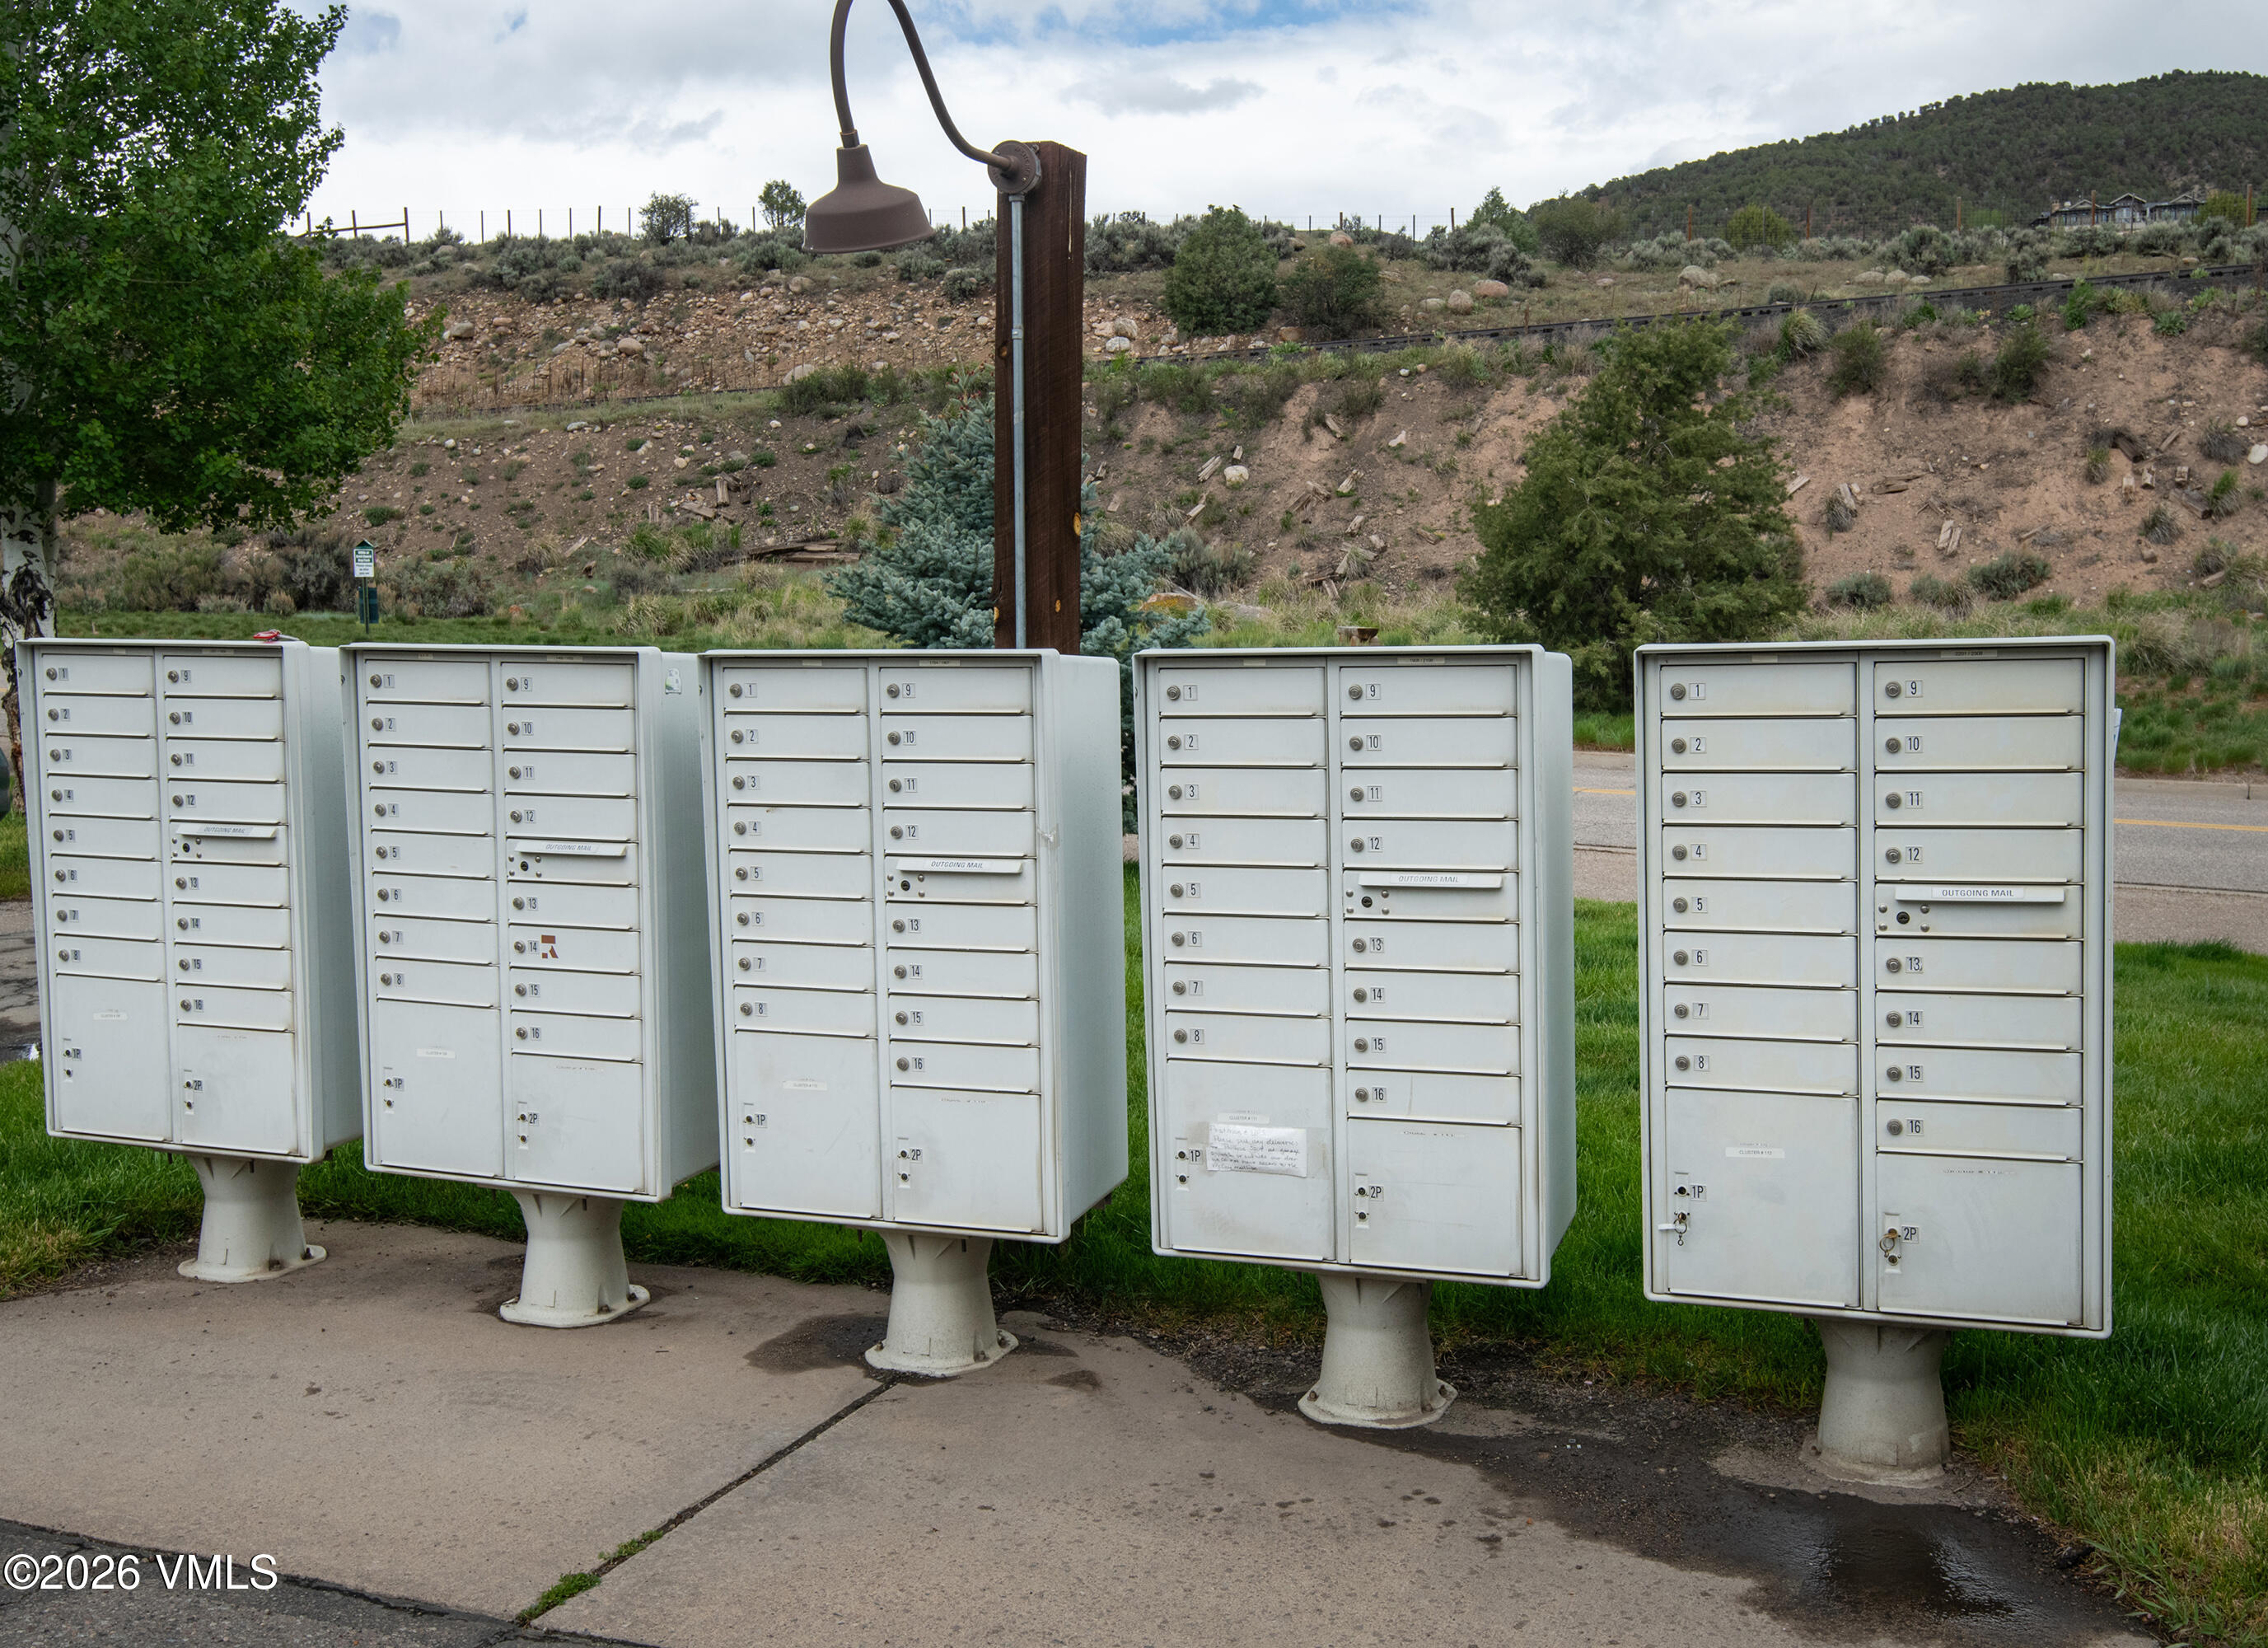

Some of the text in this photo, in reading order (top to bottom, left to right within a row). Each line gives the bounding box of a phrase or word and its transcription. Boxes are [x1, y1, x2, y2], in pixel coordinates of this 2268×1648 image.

[523, 678, 529, 691] 9
[747, 683, 753, 695] 1
[905, 683, 911, 696] 9
[1370, 684, 1376, 698] 9
[1695, 684, 1700, 697] 1
[1910, 681, 1917, 695] 9
[1187, 686, 1193, 699] 1
[387, 718, 393, 730] 2
[523, 723, 532, 734] 10
[749, 729, 755, 742] 2
[905, 731, 914, 744] 10
[1188, 734, 1194, 748] 2
[1369, 735, 1379, 749] 10
[1695, 737, 1701, 751] 2
[1908, 737, 1920, 751] 10
[389, 761, 395, 773] 3
[525, 766, 532, 778] 11
[751, 775, 756, 789] 3
[906, 778, 915, 790] 11
[1189, 784, 1195, 798] 3
[1370, 787, 1379, 799] 11
[1695, 791, 1702, 805] 3
[1909, 792, 1920, 806] 11
[390, 804, 396, 815] 4
[526, 811, 534, 822] 12
[752, 822, 758, 832] 4
[907, 825, 916, 838] 12
[1190, 835, 1195, 847] 4
[1370, 836, 1380, 850] 12
[392, 847, 397, 859] 5
[1695, 845, 1702, 858] 4
[1908, 847, 1920, 861] 12
[754, 867, 760, 879] 5
[1398, 875, 1438, 883] OUTGOING
[394, 889, 399, 901] 6
[1190, 883, 1196, 896] 5
[1942, 889, 2014, 897] OUTGOING MAIL
[528, 897, 537, 910] 13
[1696, 897, 1703, 911] 5
[755, 912, 760, 925] 6
[910, 919, 919, 931] 13
[1191, 931, 1198, 945] 6
[529, 941, 538, 953] 14
[1372, 938, 1382, 952] 13
[757, 957, 762, 969] 7
[1696, 950, 1703, 964] 6
[911, 965, 920, 976] 14
[1908, 957, 1920, 971] 13
[530, 984, 539, 996] 15
[1193, 981, 1199, 994] 7
[1372, 988, 1382, 1000] 14
[758, 1002, 764, 1015] 8
[1697, 1003, 1704, 1017] 7
[912, 1011, 921, 1023] 15
[1908, 1011, 1920, 1025] 14
[531, 1028, 540, 1039] 16
[1194, 1029, 1200, 1042] 8
[1373, 1037, 1383, 1051] 15
[914, 1057, 923, 1070] 16
[1698, 1056, 1705, 1070] 8
[1909, 1065, 1920, 1080] 15
[394, 1078, 403, 1090] 1P
[1374, 1087, 1384, 1101] 16
[529, 1112, 538, 1125] 2P
[756, 1114, 766, 1126] 1P
[1909, 1119, 1921, 1134] 16
[911, 1149, 922, 1161] 2P
[1190, 1149, 1201, 1162] 1P
[1370, 1186, 1382, 1199] 2P
[1691, 1185, 1704, 1199] 1P
[1903, 1226, 1917, 1241] 2P
